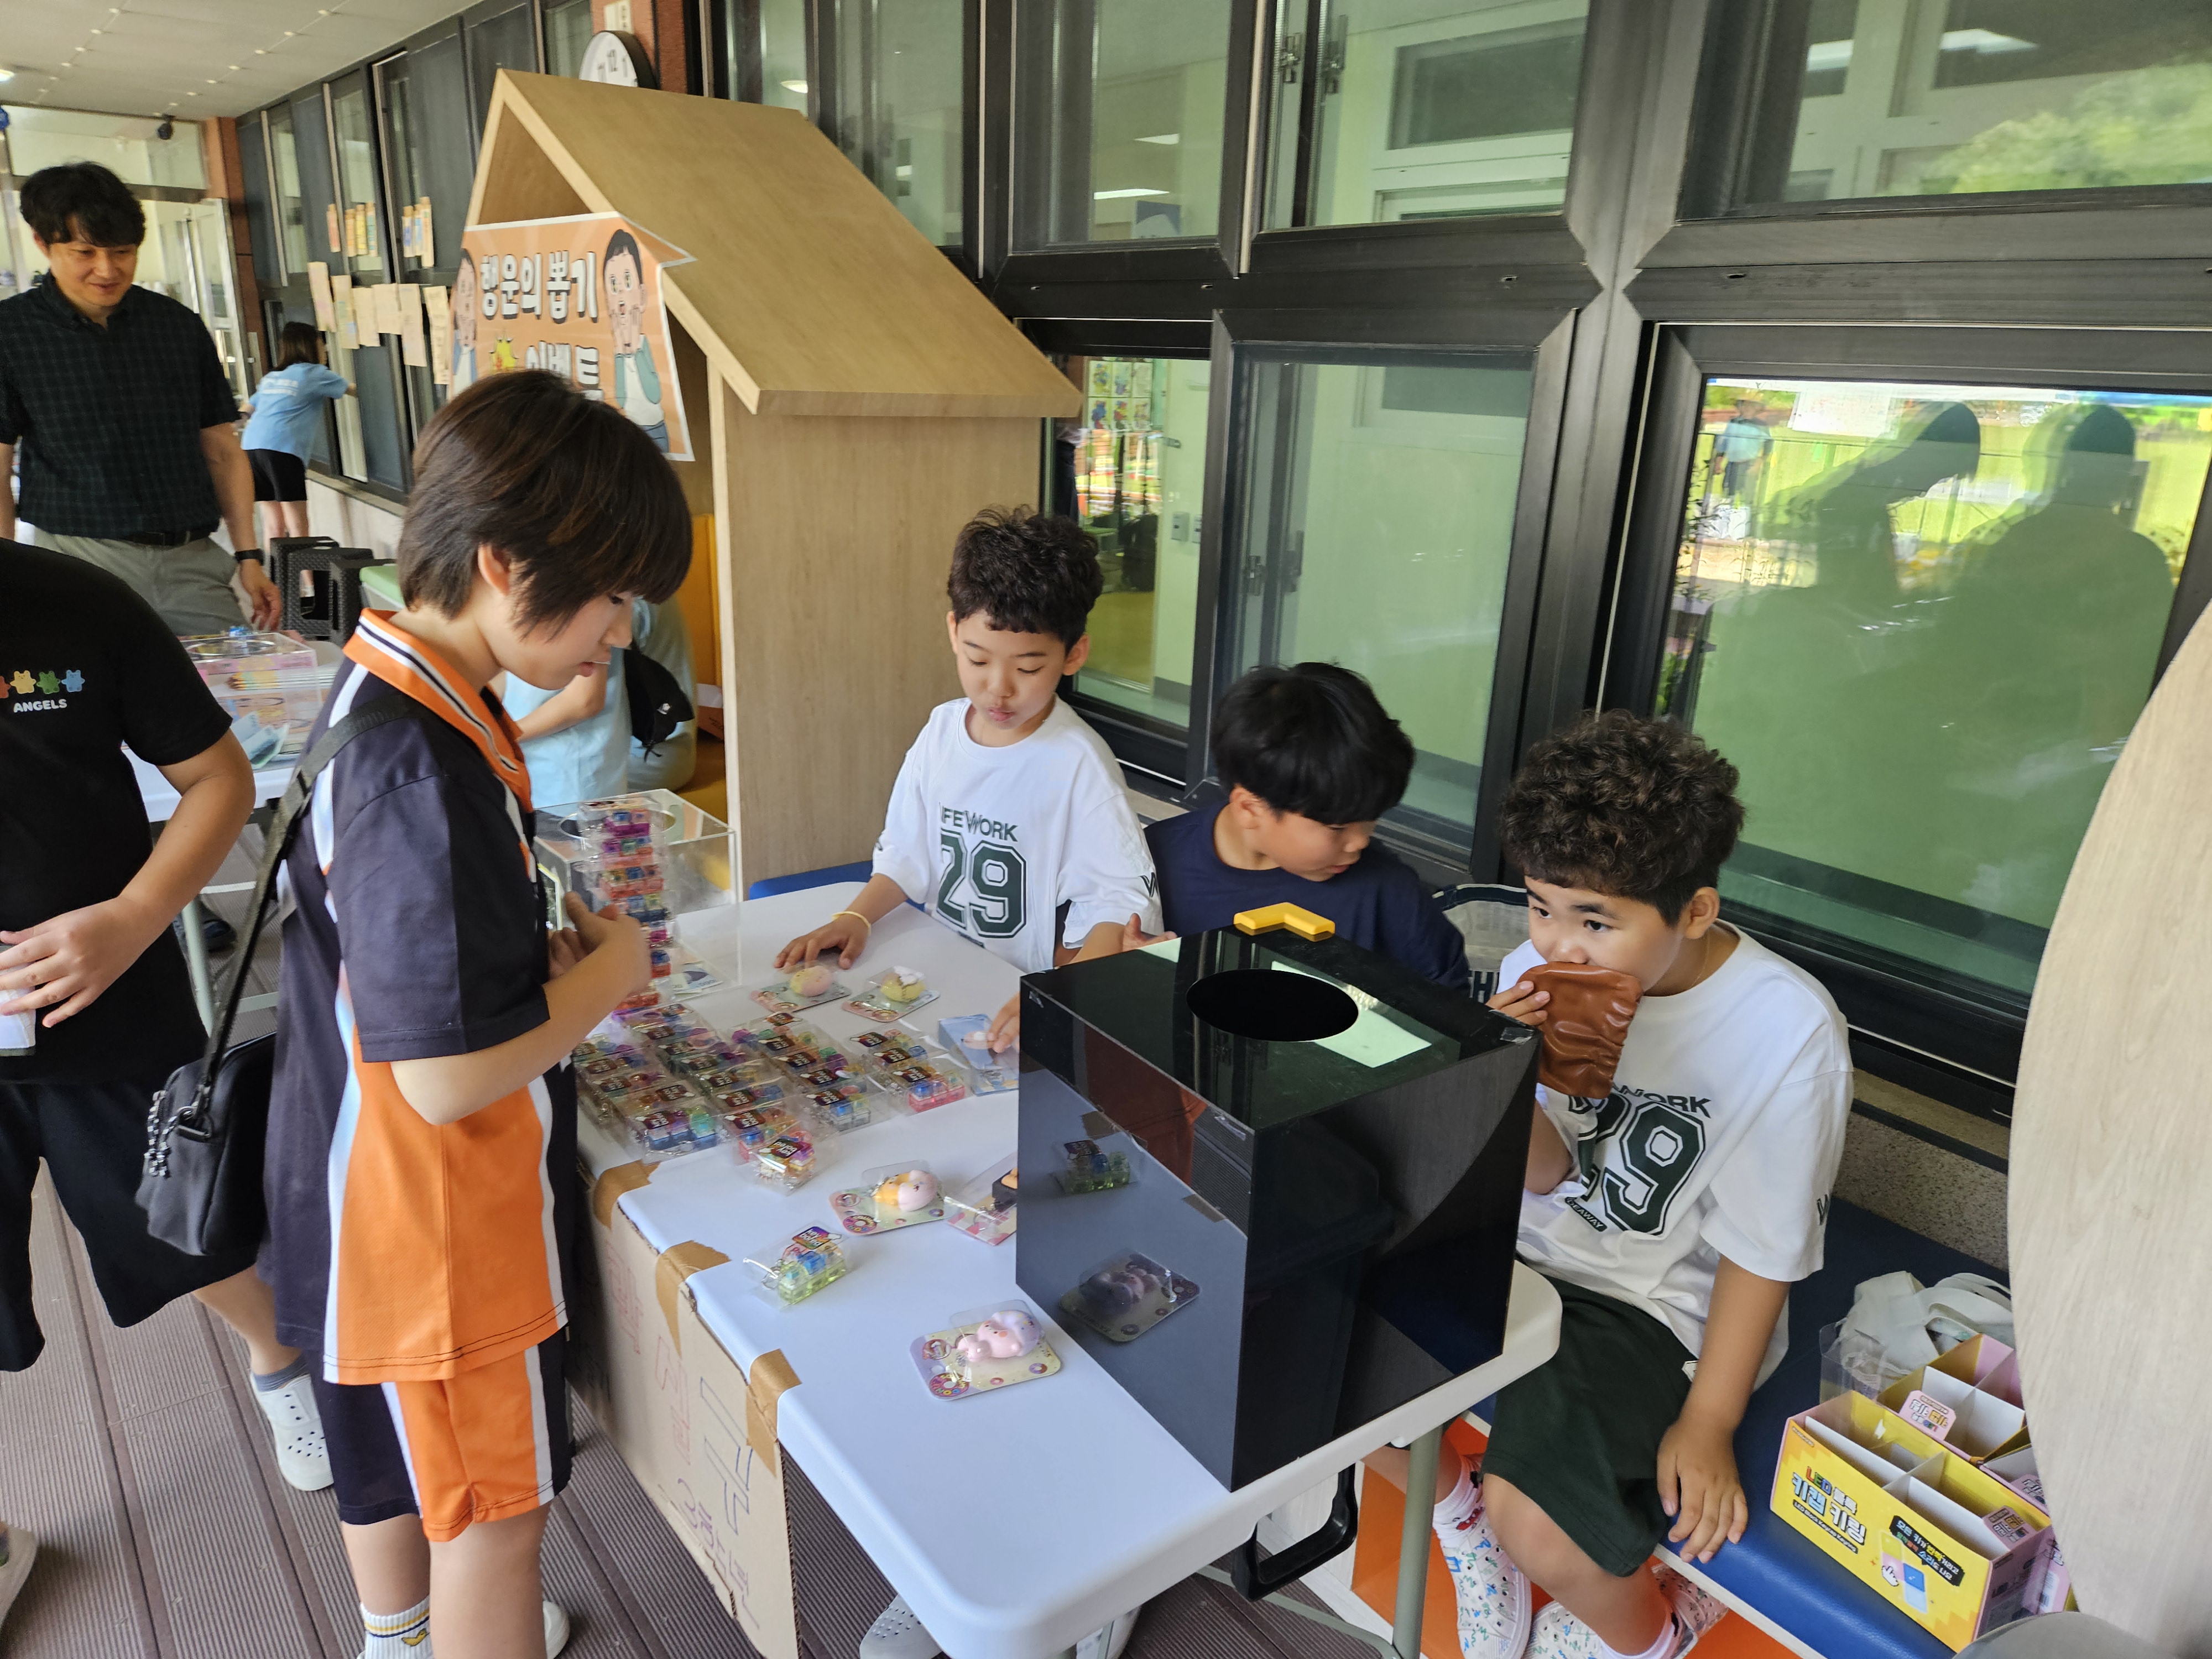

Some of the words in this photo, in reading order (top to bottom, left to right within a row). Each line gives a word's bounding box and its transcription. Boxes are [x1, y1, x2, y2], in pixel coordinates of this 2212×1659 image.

[480, 252, 542, 320] 행운의
[546, 249, 598, 324] 뽑기
[13, 698, 67, 713] ANGELS
[939, 805, 1019, 842] FEWORK
[936, 828, 1027, 939] 29
[1566, 1197, 1604, 1228] DEAWAY
[806, 1228, 822, 1239] key
[1910, 1399, 1929, 1417] 키링
[1806, 1466, 1832, 1496] LED
[1792, 1472, 1827, 1516] 키캡
[1830, 1501, 1866, 1546] 키링
[1896, 1520, 1912, 1536] 모든
[1918, 1551, 1939, 1570] 소리도
[1939, 1568, 1953, 1580] 나요
